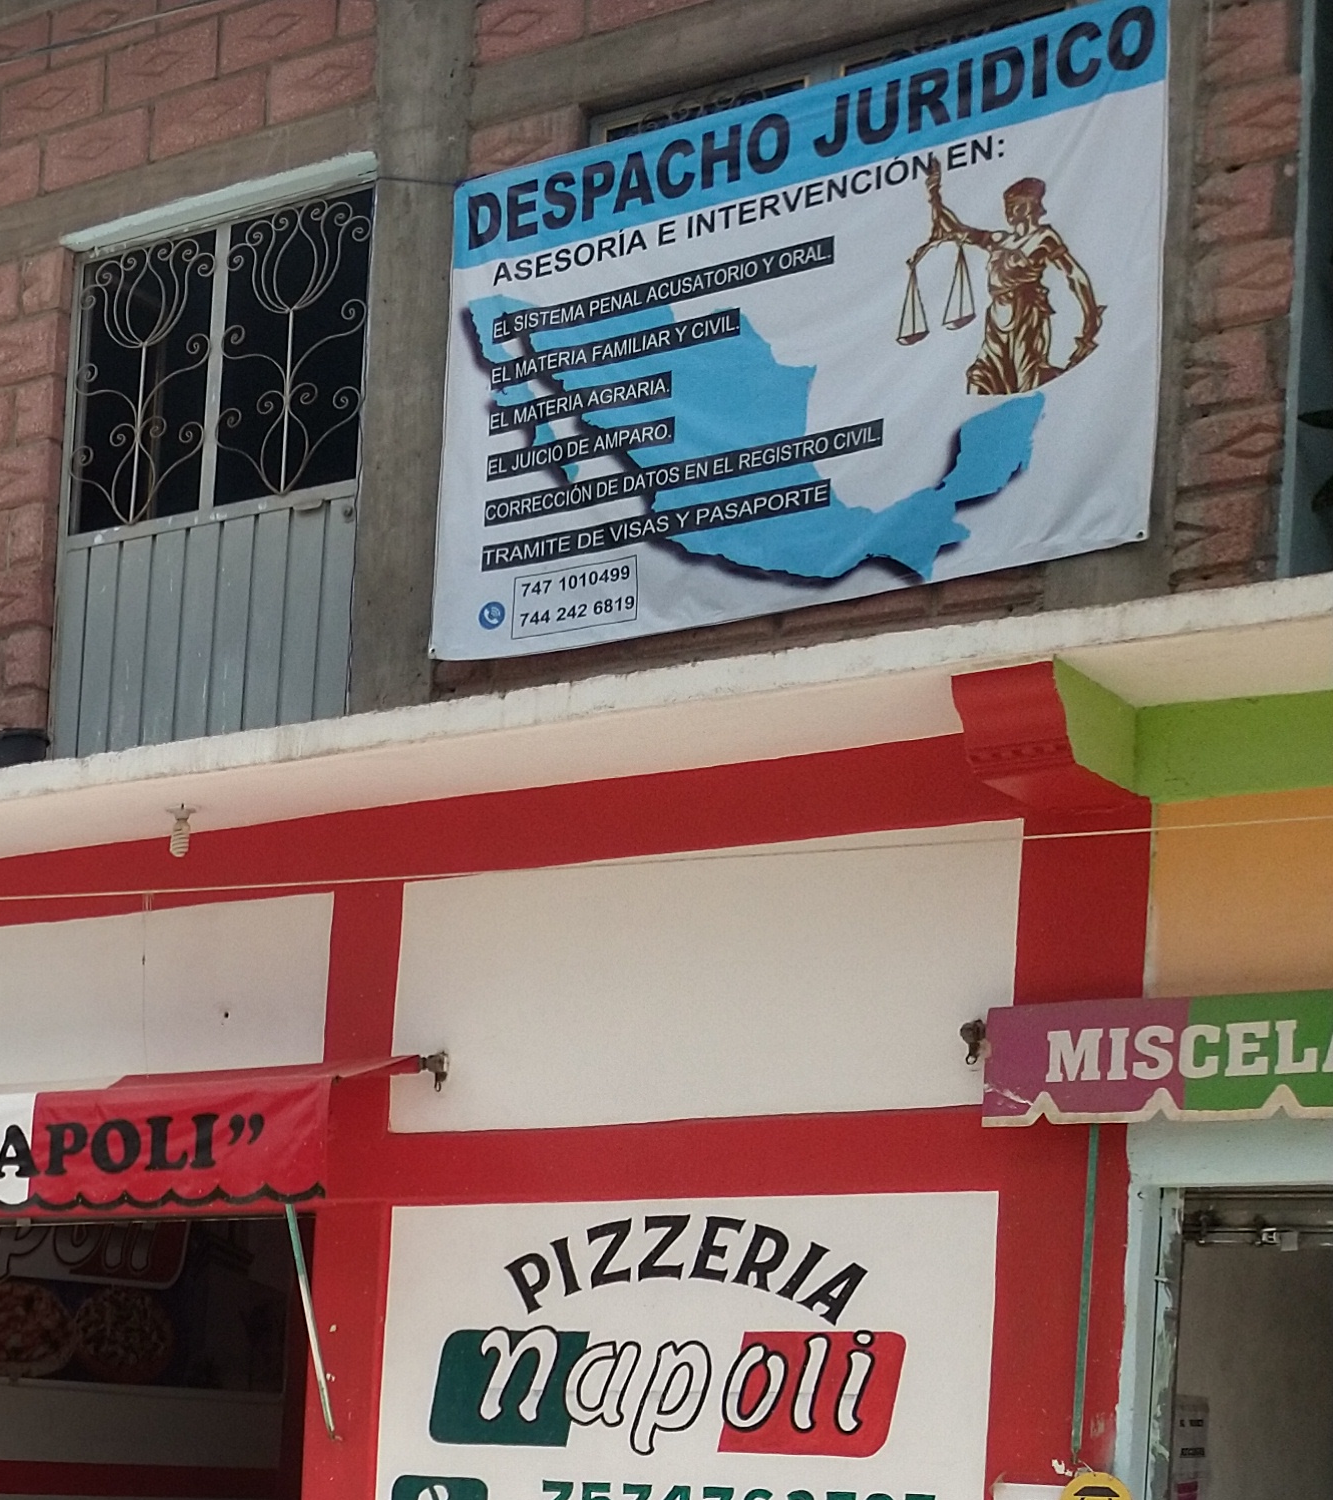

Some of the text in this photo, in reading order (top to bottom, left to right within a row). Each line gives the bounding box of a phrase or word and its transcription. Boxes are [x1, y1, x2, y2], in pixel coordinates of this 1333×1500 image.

[467, 6, 1155, 250] DESPACHO JURIDICO
[493, 136, 1006, 286] ASESORÍA E INTERVENCIÓN EN:
[493, 245, 832, 339] EL SISTEMA PENAL ACUSATORIO Y ORAL.
[491, 315, 740, 385] EL MATERIA FAMILIAR Y CIVIL.
[490, 378, 670, 430] EL MATERIA AGRARIA.
[485, 425, 882, 521] CORRECCIÓN DE DATOS EN EL REGISTRO CIVIL.
[488, 422, 672, 475] EL JUICIO DE AMPARO.
[483, 485, 828, 566] TRAMITE DE VISAS Y PASAPORTE
[519, 595, 635, 628] 744 242 6819
[520, 565, 631, 598] 747 1010499
[1045, 1019, 1333, 1083] MISCEL
[504, 1213, 869, 1327] PIZZERIA
[478, 1325, 876, 1457] napoli
